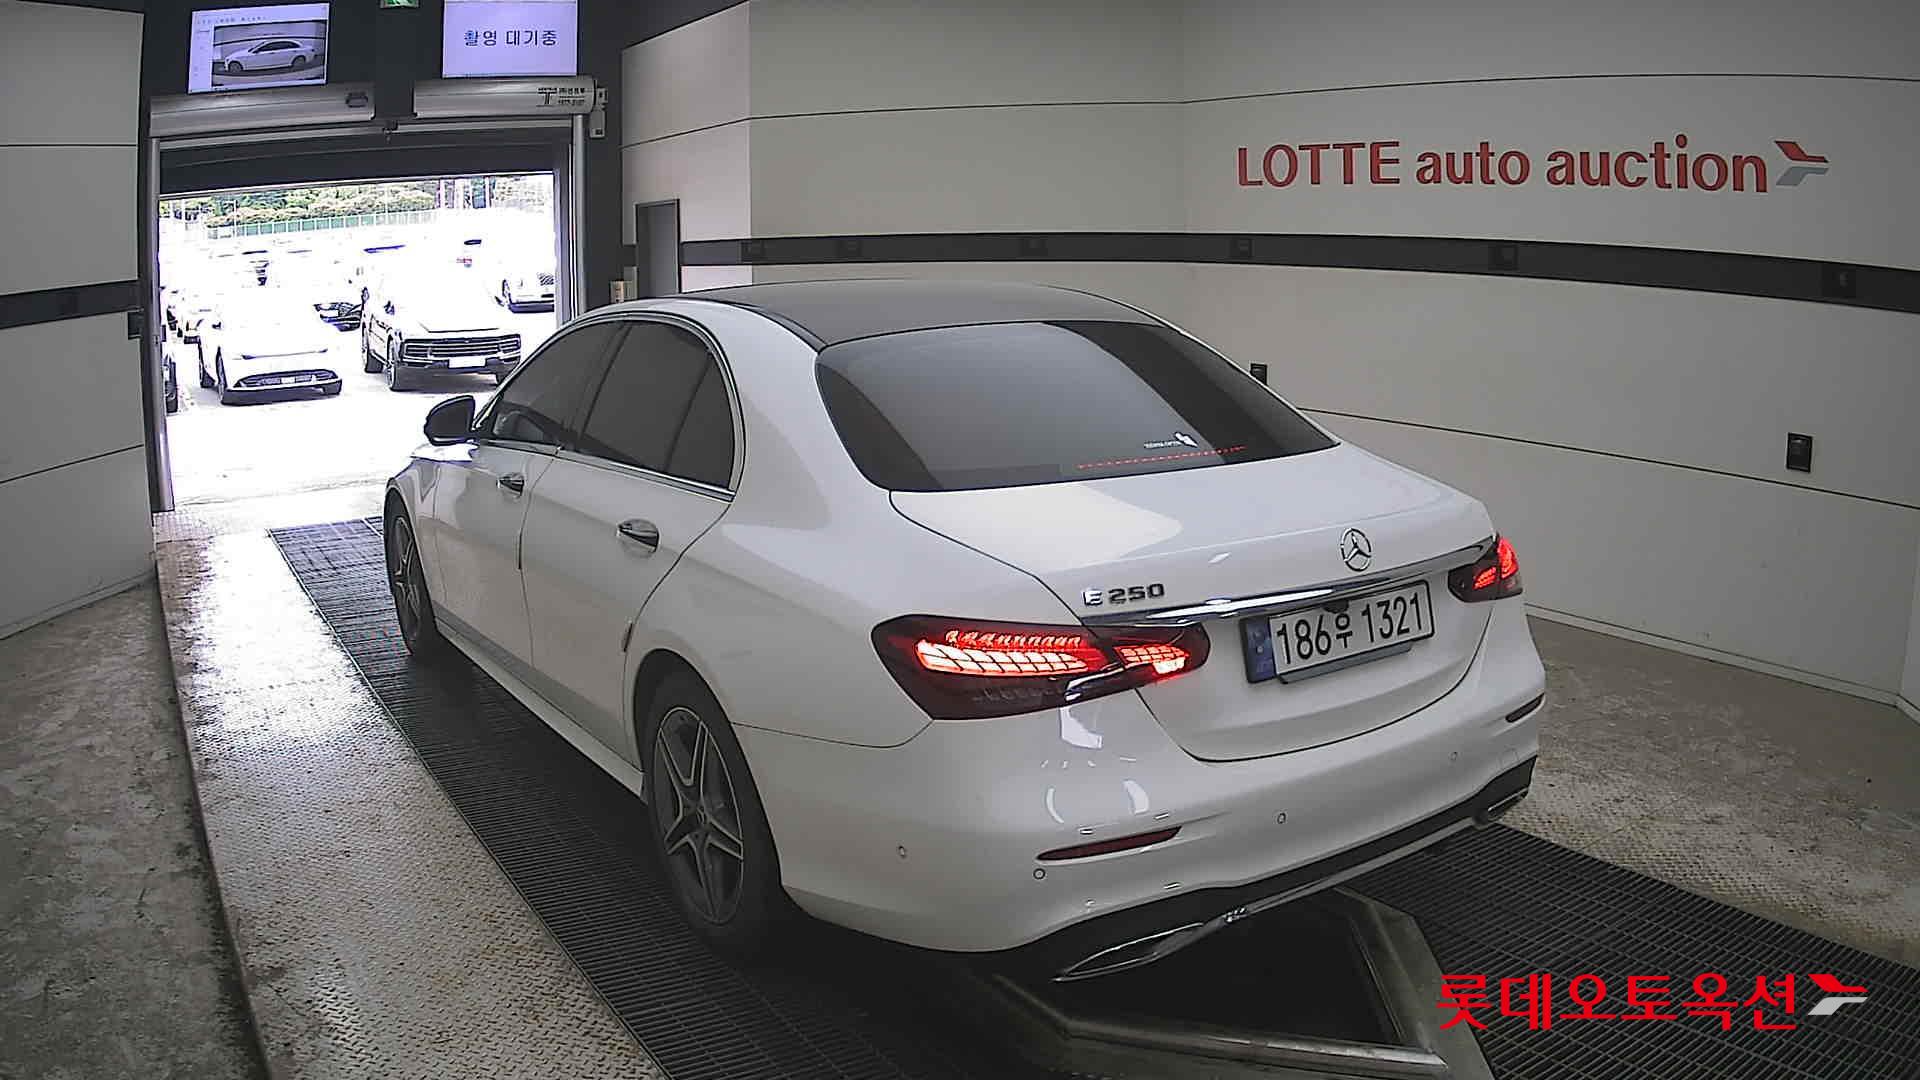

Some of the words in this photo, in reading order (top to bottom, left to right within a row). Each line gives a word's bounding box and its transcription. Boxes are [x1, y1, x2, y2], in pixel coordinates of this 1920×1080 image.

[464, 30, 497, 46] 촬영
[506, 30, 557, 46] 대기중
[1238, 141, 1400, 187] LOTTE
[1416, 142, 1530, 185] auto
[1547, 134, 1768, 193] auction
[1082, 589, 1103, 606] E
[1108, 583, 1165, 604] 250
[1276, 613, 1353, 664] 186우
[1361, 592, 1422, 642] 1321
